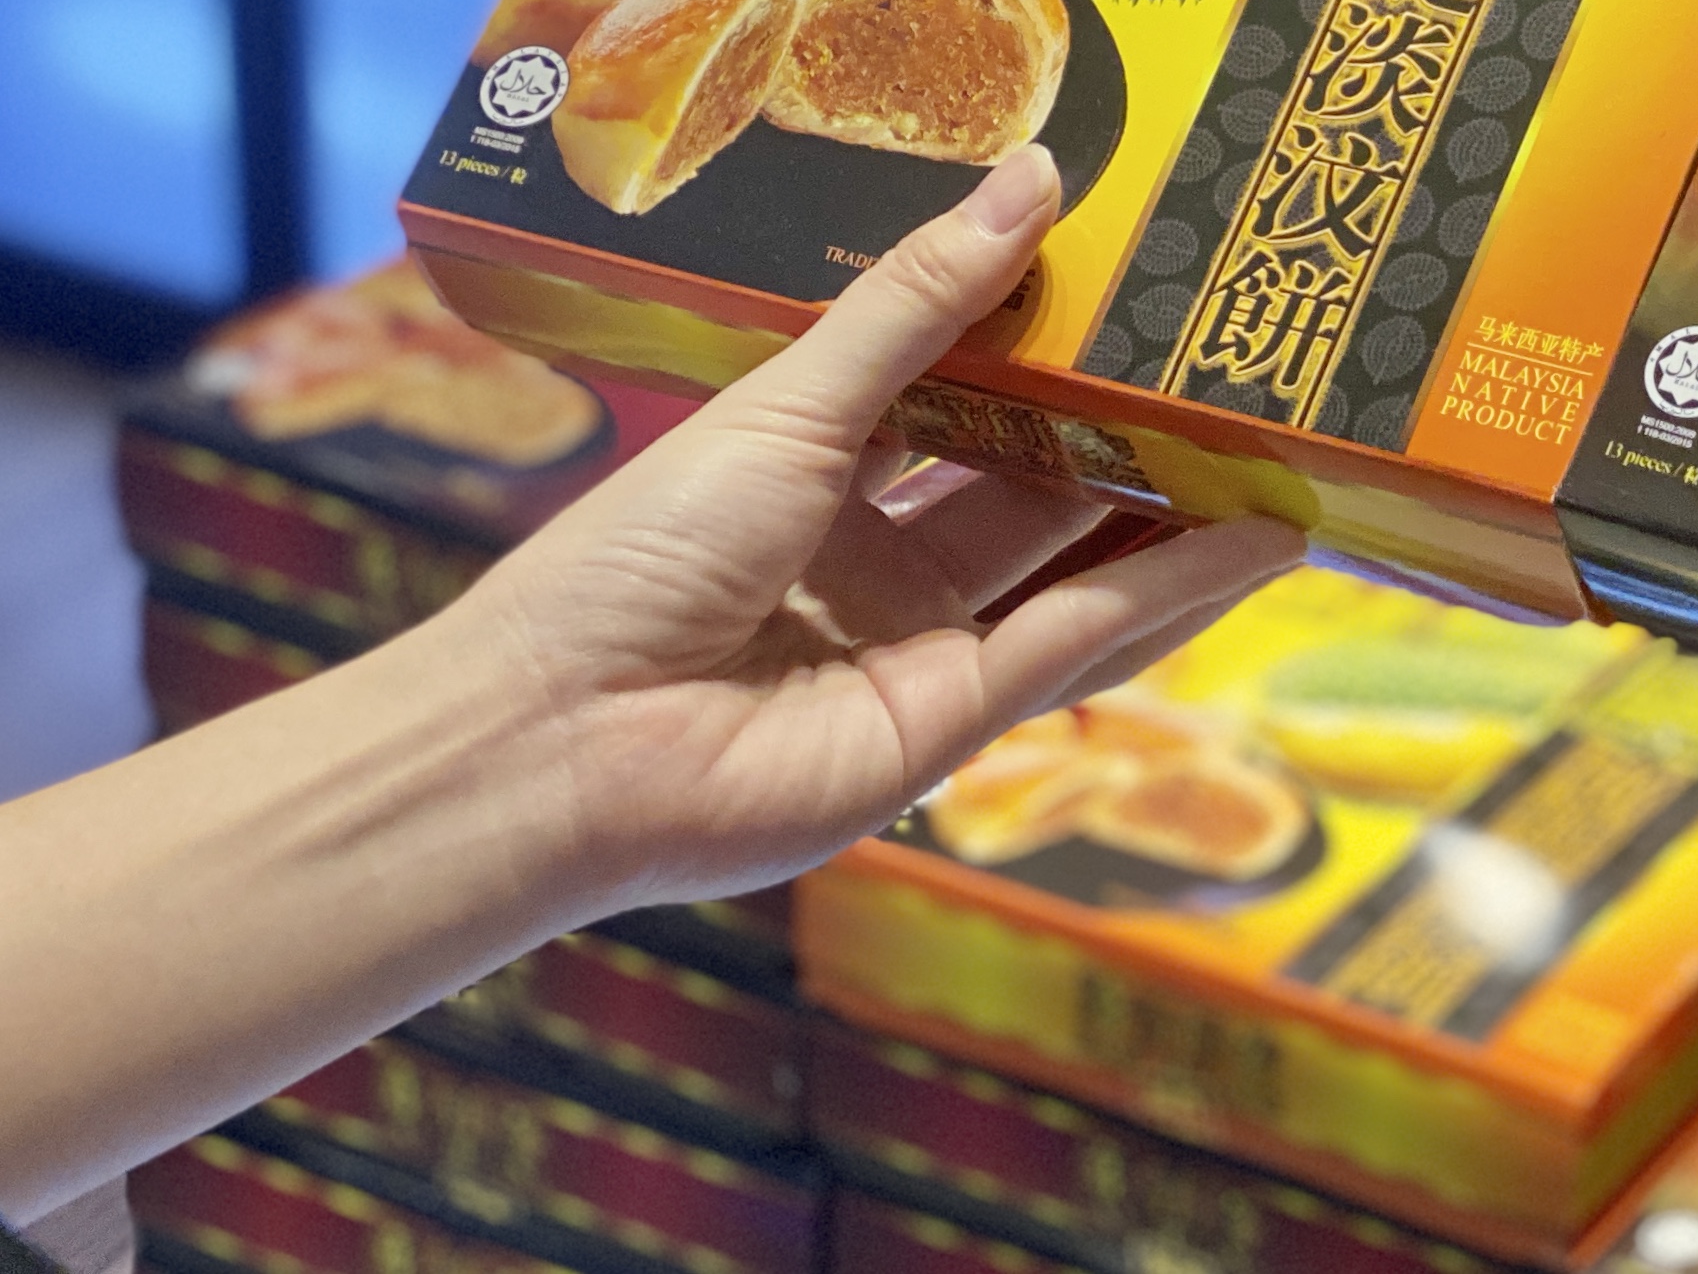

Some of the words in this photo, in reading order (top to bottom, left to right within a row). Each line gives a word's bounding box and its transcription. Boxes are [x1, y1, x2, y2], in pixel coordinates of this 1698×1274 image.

[439, 149, 457, 166] 13
[455, 154, 500, 178] pieces
[1475, 315, 1604, 365] 马来西亚特产
[1448, 372, 1581, 422] NATIVE
[1458, 349, 1585, 401] MALAYSIA
[1440, 395, 1573, 446] PRODUCT
[1604, 440, 1623, 459] 13
[1623, 448, 1673, 476] pieces
